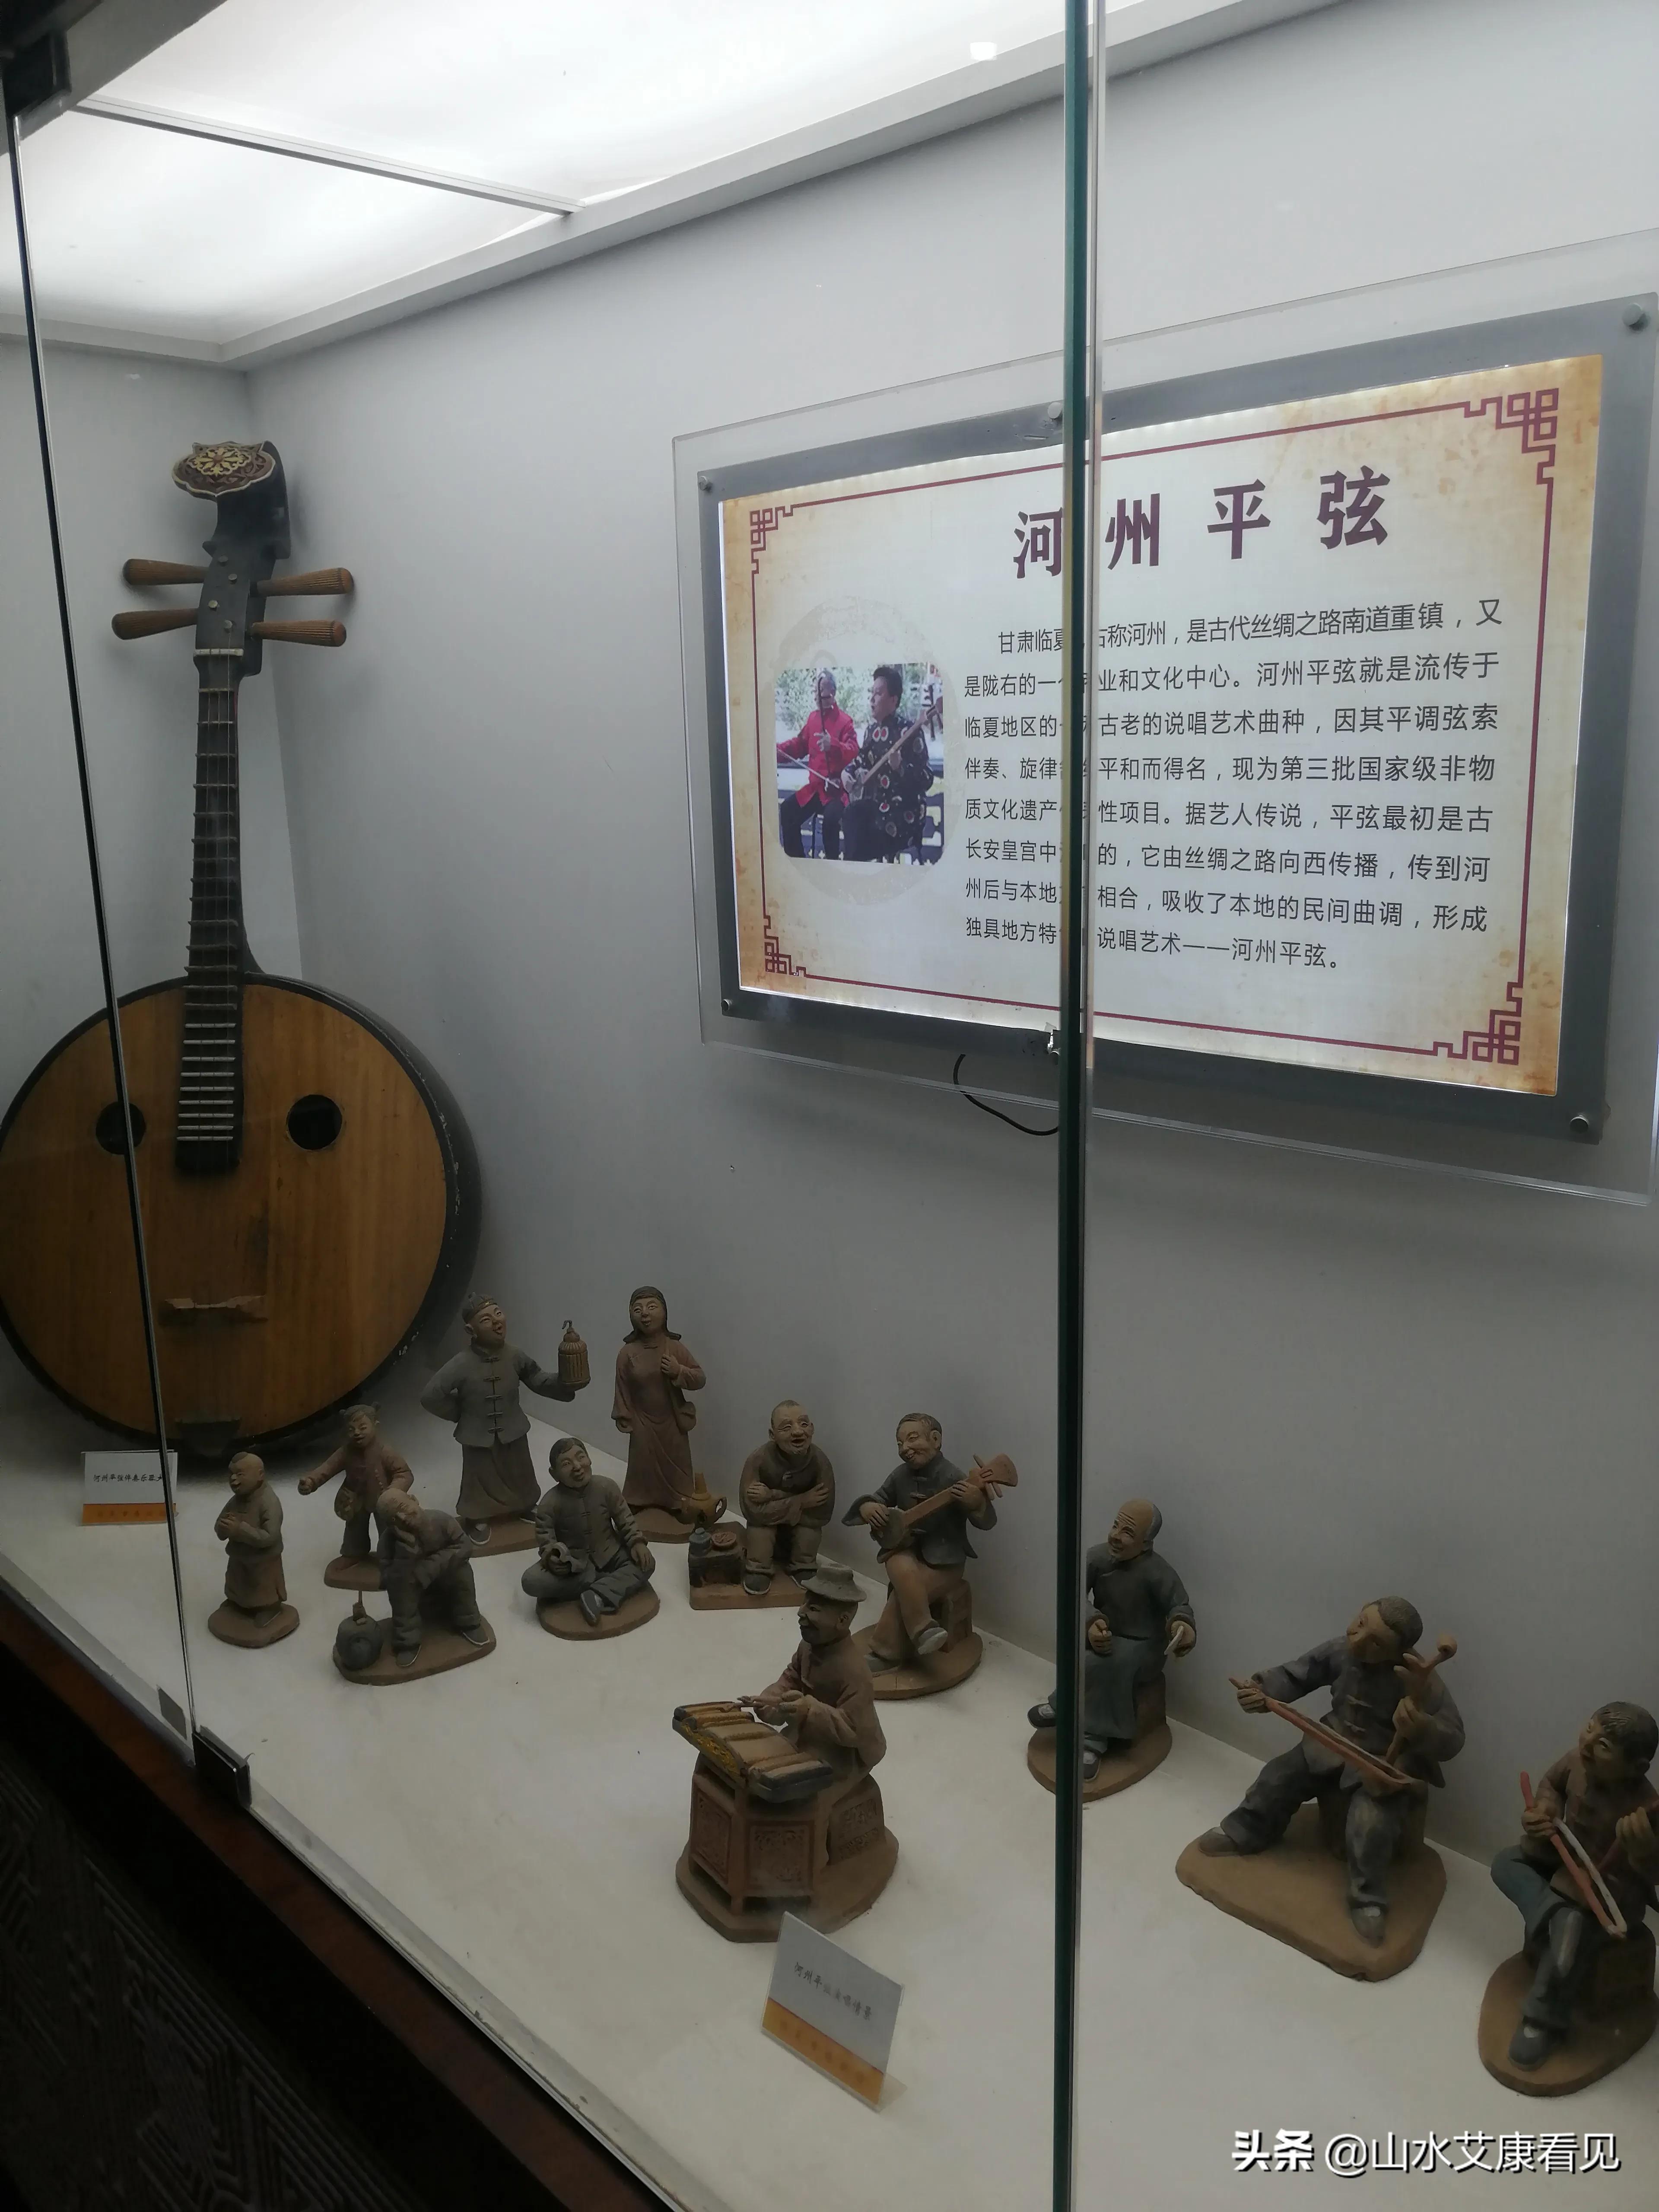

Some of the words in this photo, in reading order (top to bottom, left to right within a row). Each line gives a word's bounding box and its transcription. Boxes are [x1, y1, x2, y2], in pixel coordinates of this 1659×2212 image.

[1013, 466, 1390, 579] 河州平弦
[998, 599, 1502, 655] 甘肃临夏称河州，是古代丝绸之路南道重镇，又
[965, 652, 1499, 697] 是陇右的一业和文化中心。河州平弦就是流传于
[965, 703, 1498, 738] 临夏地区的古老的说唱艺术曲种，因其平调弦索
[965, 755, 1495, 782] 伴奏、旋律平和而得名，现为第三批国家级非物
[965, 798, 1493, 833] 质文化遗产性项目。据艺人传说，平弦最初是古
[966, 838, 1491, 883] 长安皇宫中的，它由丝绸之路向西传播，传到河
[966, 878, 1487, 932] 州后与本地相合，吸收了本地的民间曲调，形成
[966, 917, 1338, 969] 独具地方特说唱艺术——河州平弦。
